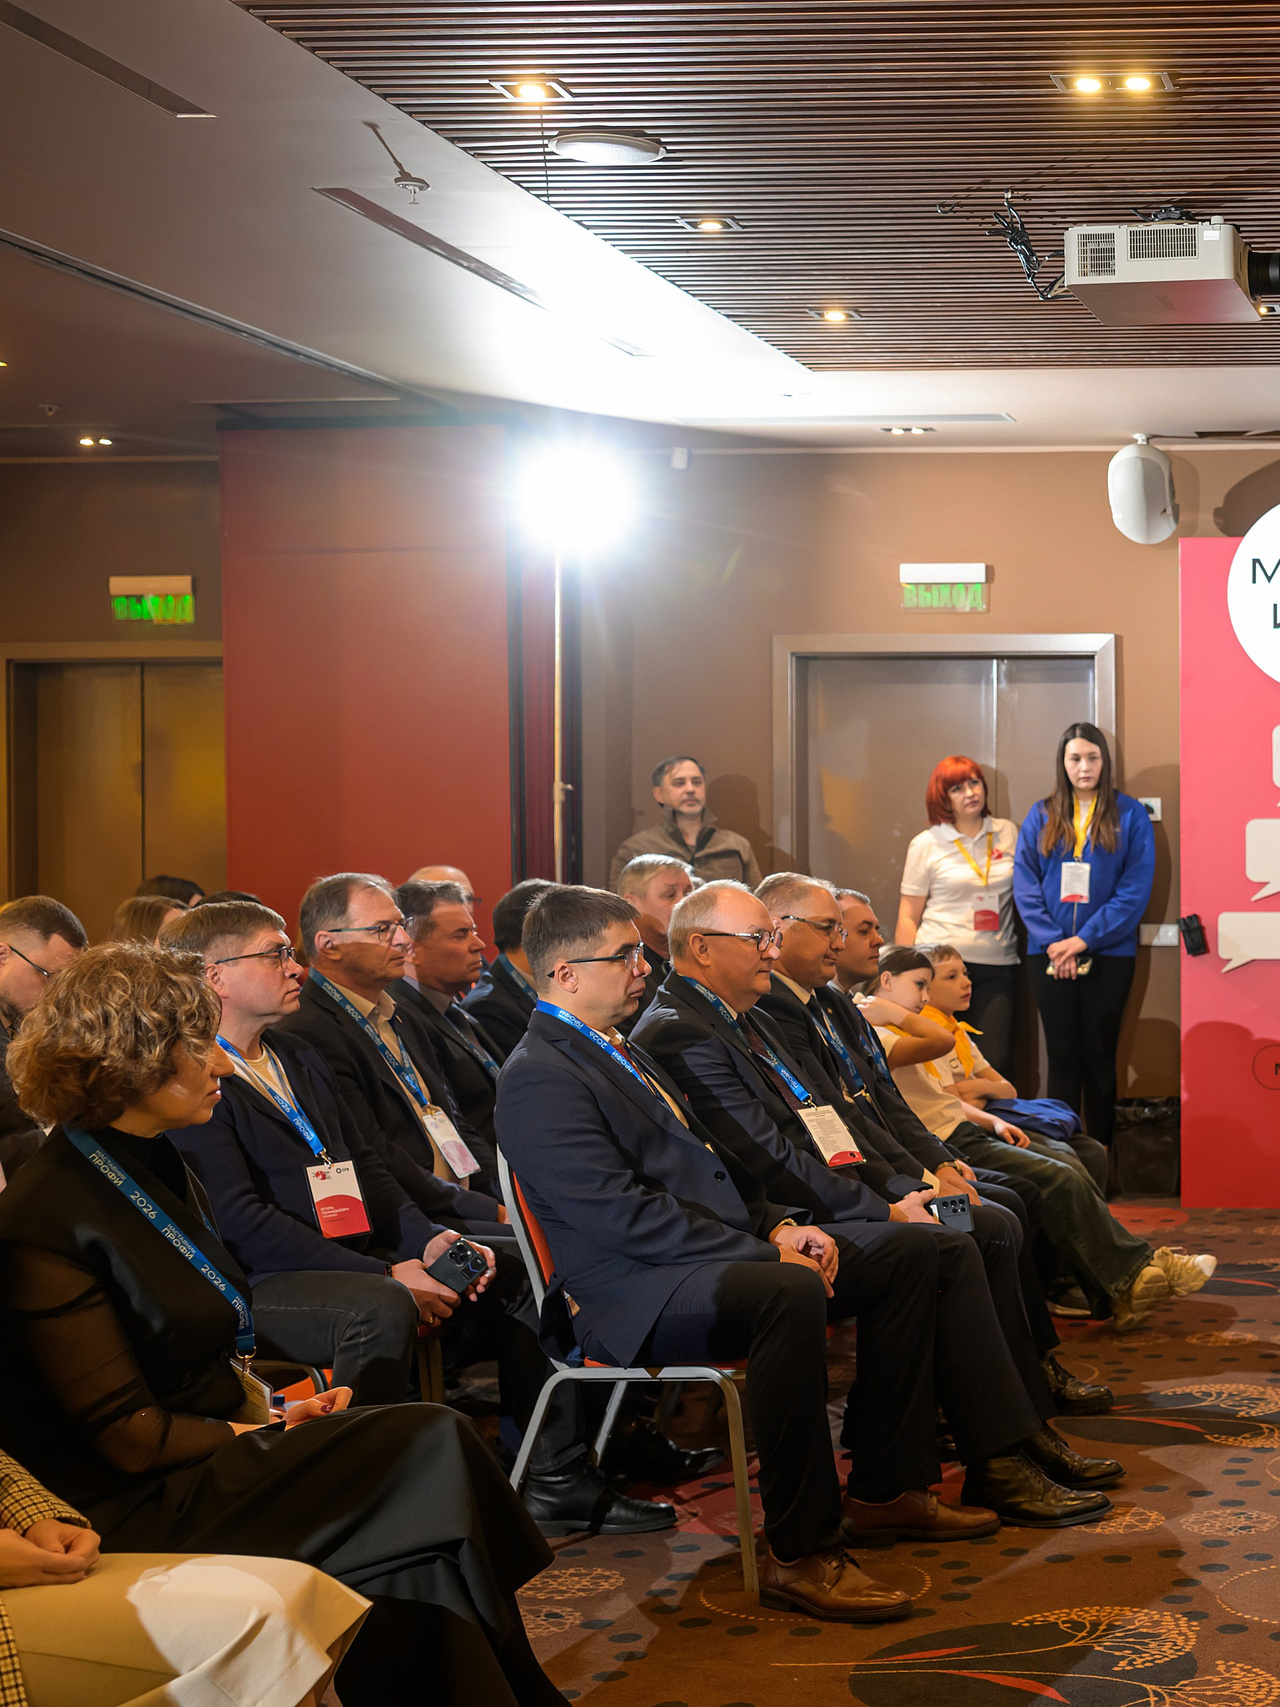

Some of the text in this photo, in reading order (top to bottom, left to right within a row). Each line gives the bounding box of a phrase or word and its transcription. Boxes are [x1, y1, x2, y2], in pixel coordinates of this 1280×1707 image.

[589, 1030, 608, 1050] 2026
[273, 1094, 291, 1113] 2026
[292, 1117, 313, 1142] ПРОФИ
[94, 1149, 127, 1181] НАСТАВНИК
[88, 1153, 158, 1220] ПРОФИ 2026
[166, 1223, 197, 1255] НАСТАВНИК
[161, 1227, 227, 1291] ПРОФИ 2026
